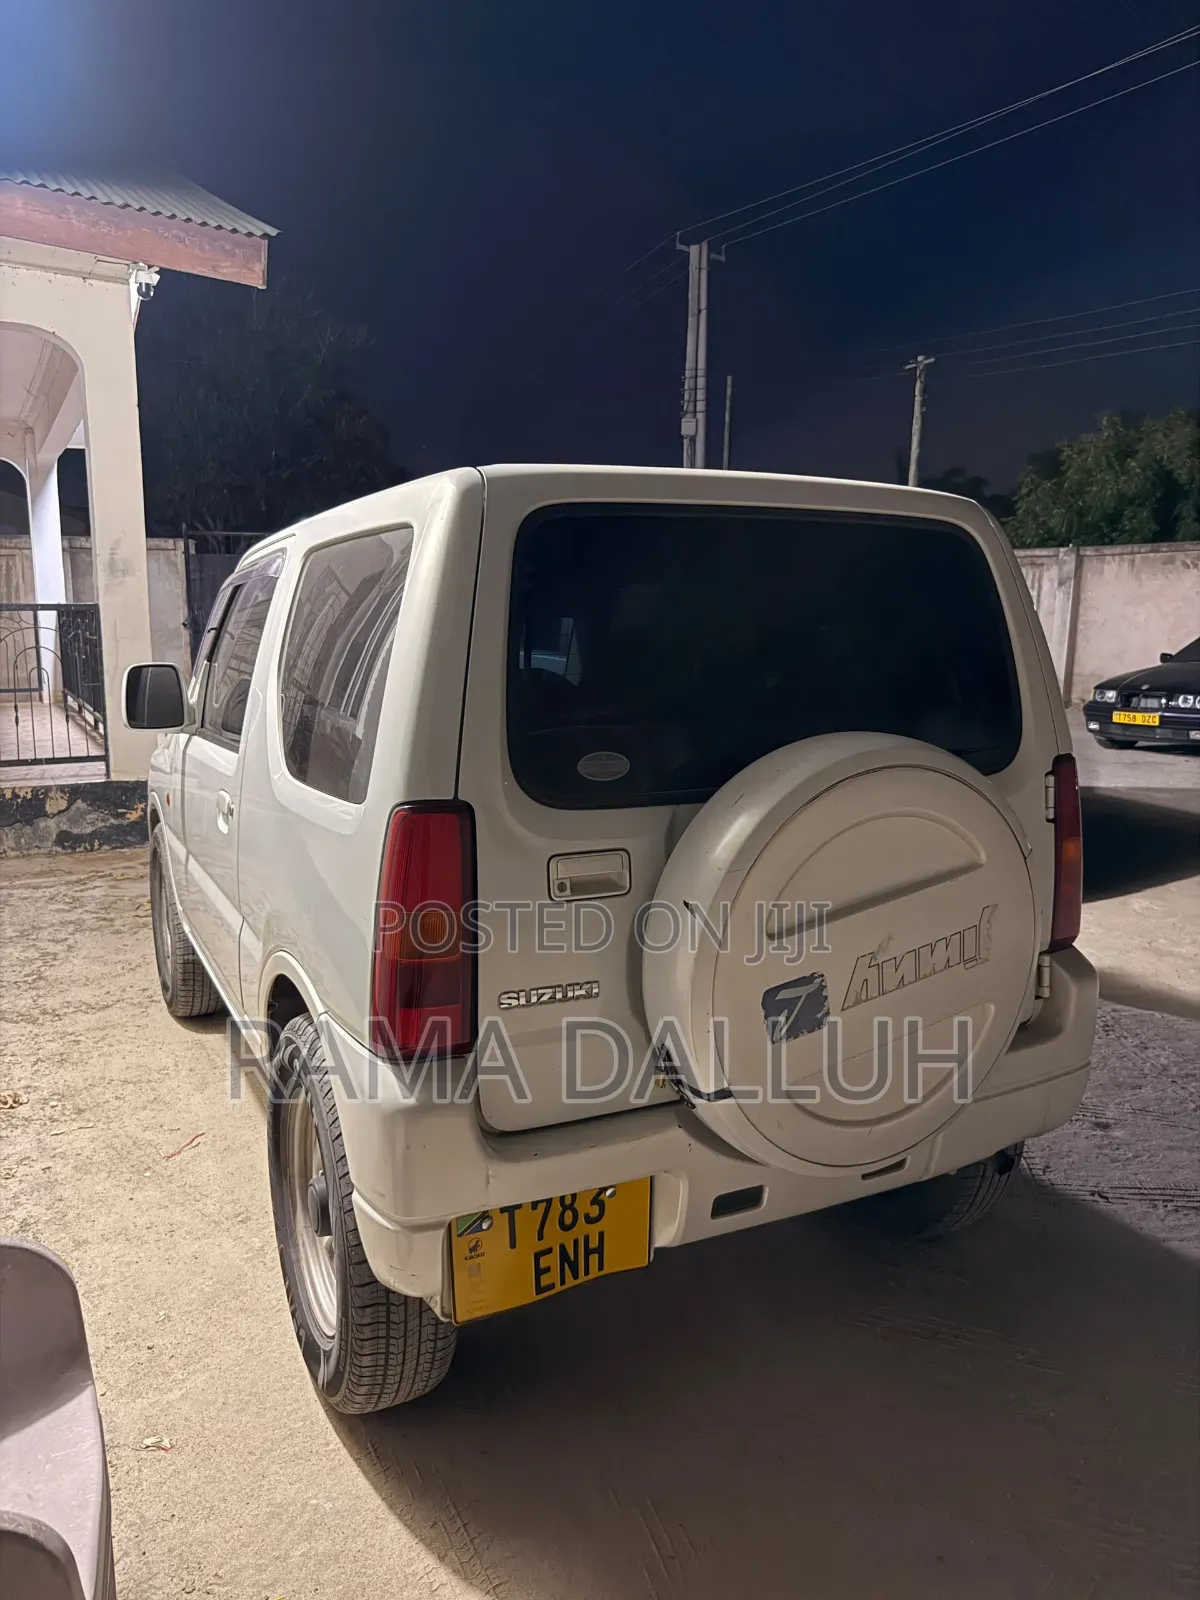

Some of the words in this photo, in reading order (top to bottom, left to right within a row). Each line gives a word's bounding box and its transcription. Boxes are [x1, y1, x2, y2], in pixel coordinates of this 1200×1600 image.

[1117, 713, 1137, 723] T758
[1141, 714, 1157, 724] DZC
[498, 980, 600, 1010] SUZUKI
[500, 1187, 606, 1250] T783
[533, 1231, 605, 1296] ENH
